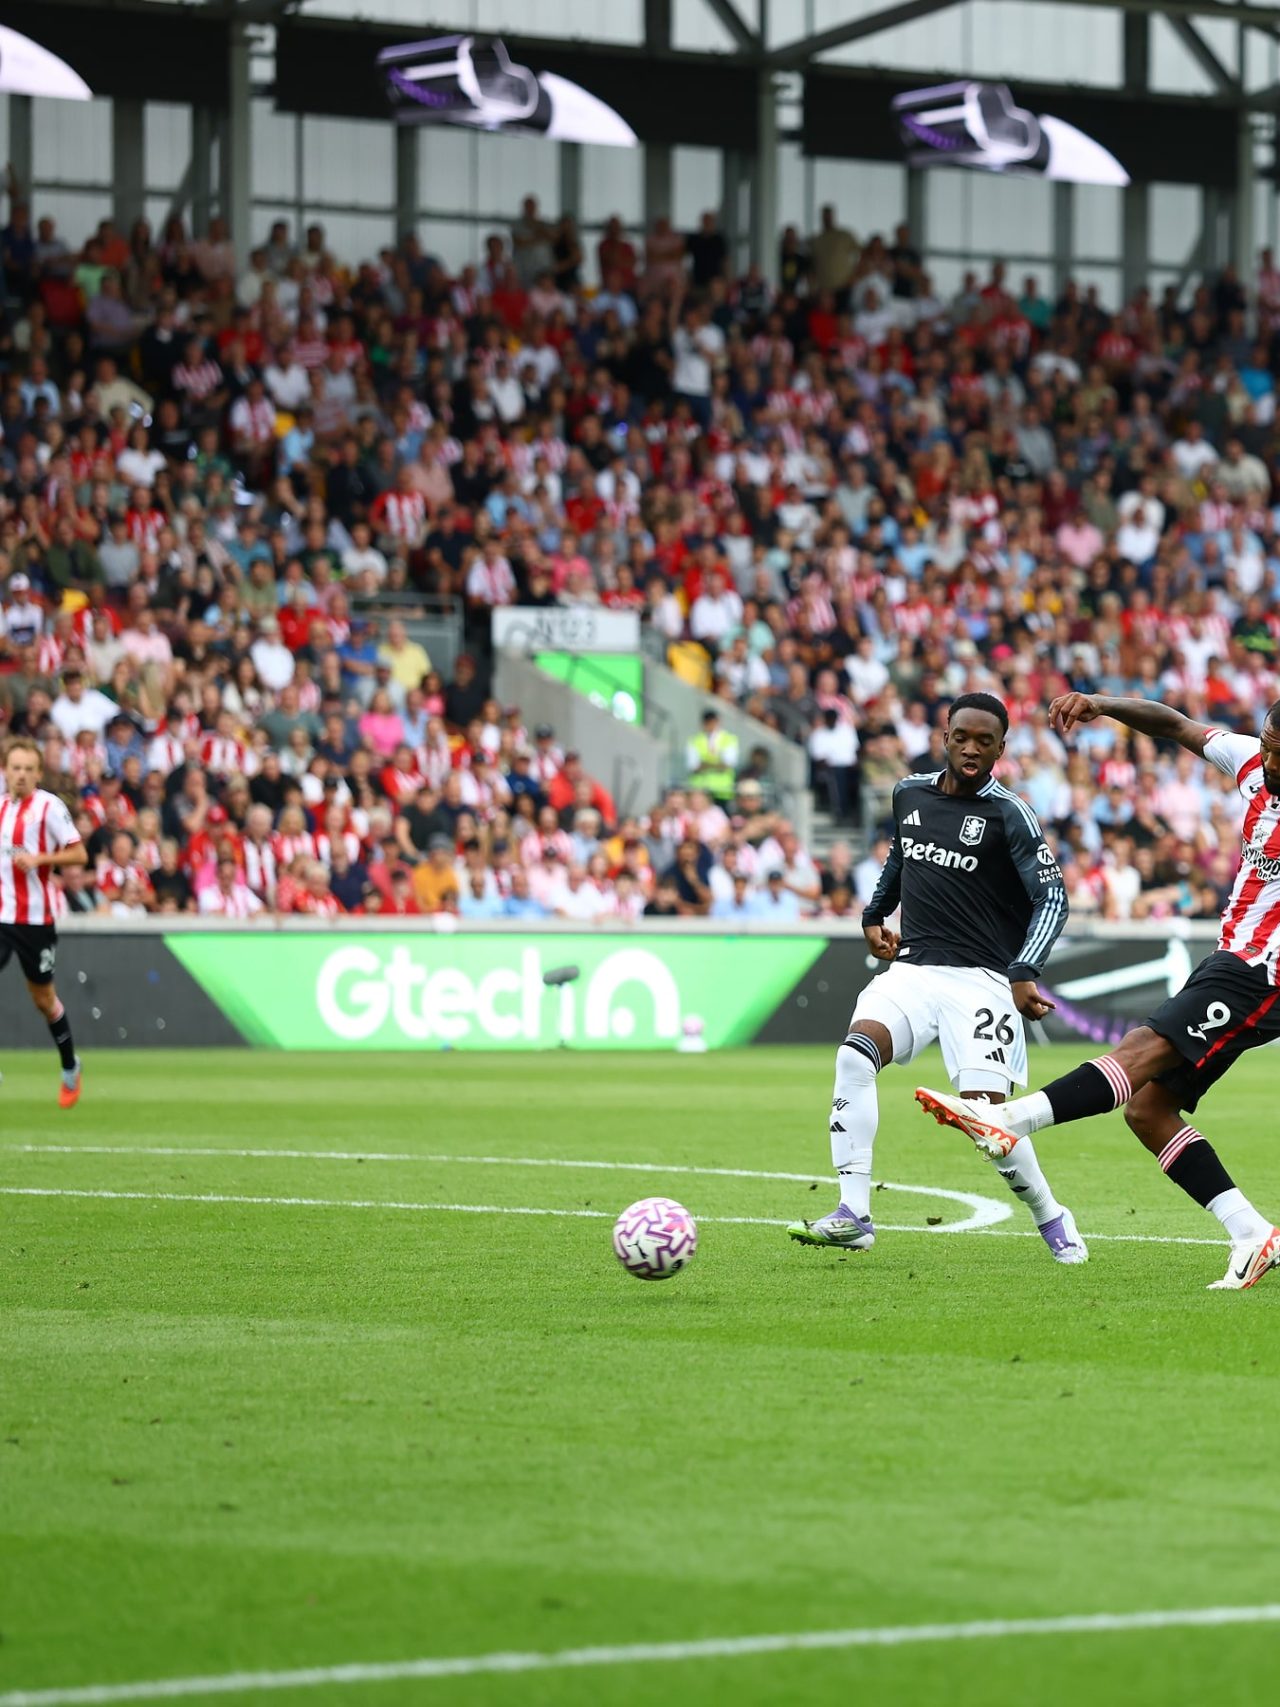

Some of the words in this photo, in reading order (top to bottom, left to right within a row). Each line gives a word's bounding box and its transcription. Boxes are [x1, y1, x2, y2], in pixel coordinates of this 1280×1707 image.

[901, 837, 979, 872] Betano
[316, 944, 575, 1040] Gtech
[973, 1007, 1015, 1046] 26
[1198, 1001, 1231, 1031] 9
